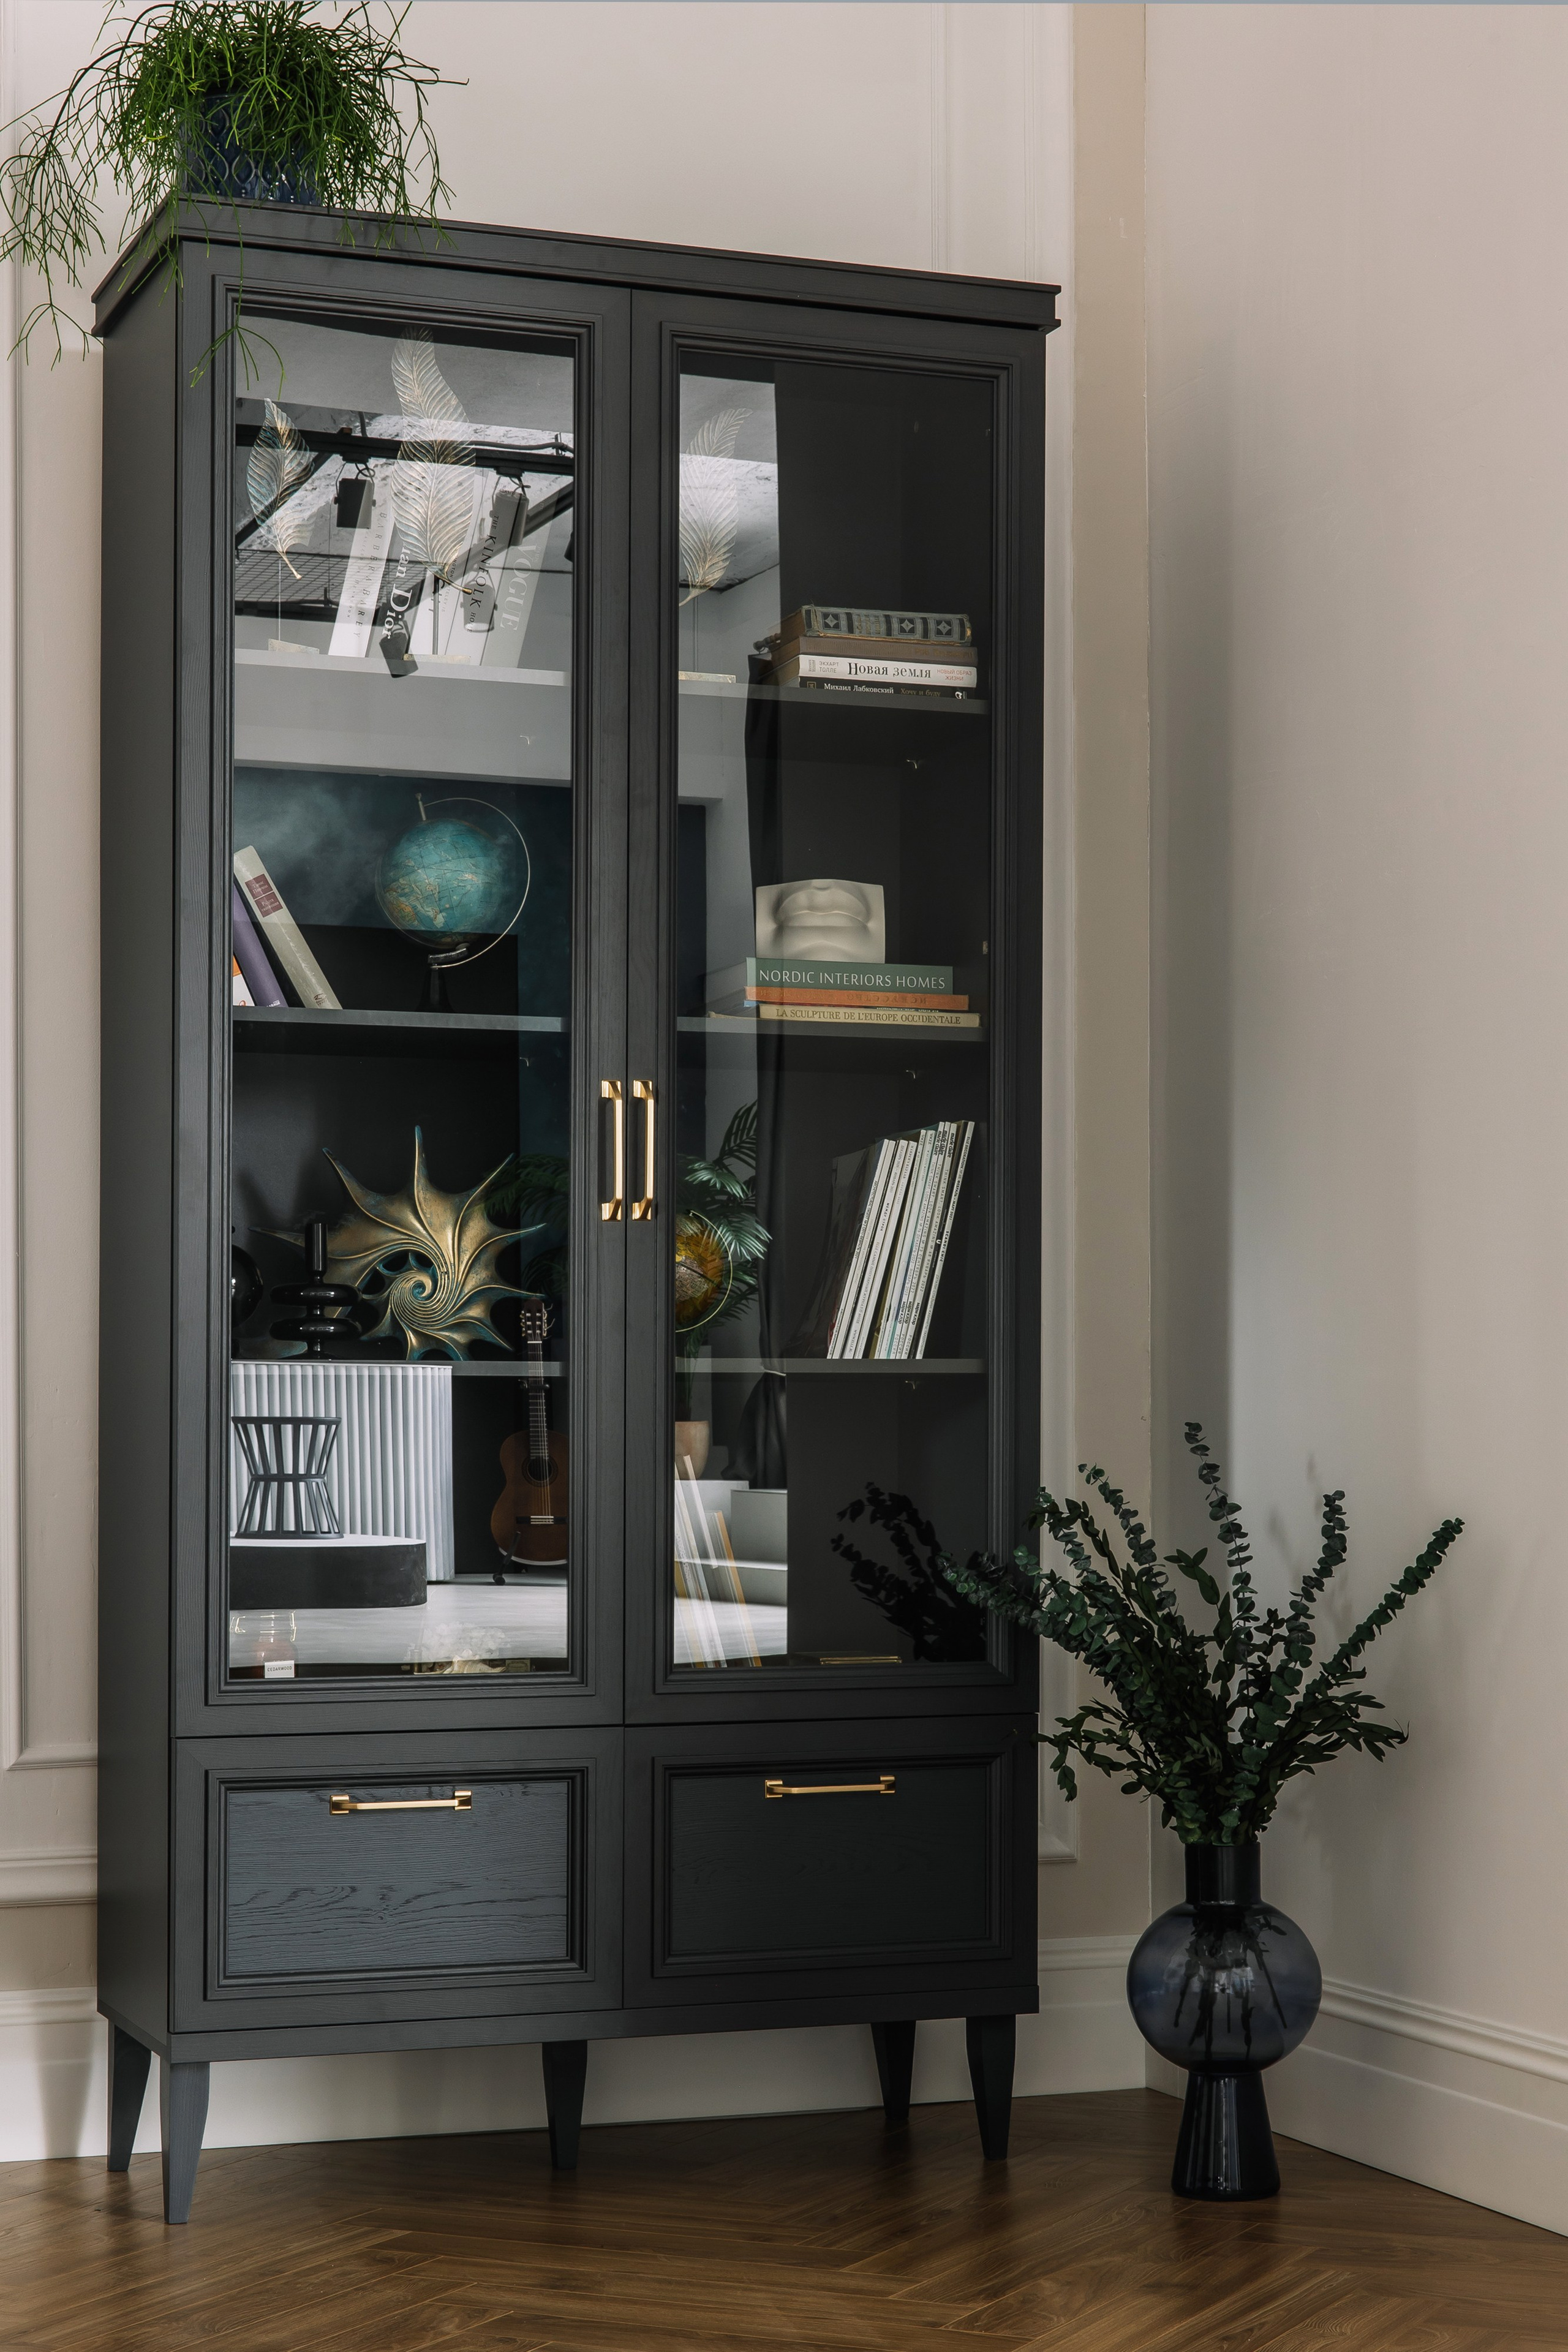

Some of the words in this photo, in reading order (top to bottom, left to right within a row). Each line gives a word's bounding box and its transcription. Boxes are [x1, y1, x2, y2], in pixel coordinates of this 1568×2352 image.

[470, 534, 497, 609] KINFOLK
[496, 540, 541, 632] VOGUE
[382, 583, 413, 641] Dior
[848, 662, 889, 676] Новая
[893, 668, 932, 679] земля
[852, 684, 894, 694] Лабковский
[759, 970, 815, 984] NORDIC
[820, 973, 892, 987] INTERIORS
[896, 976, 946, 989] HOMES
[776, 1009, 788, 1018] LA
[790, 1010, 841, 1020] SCULPTURE
[843, 1012, 857, 1021] DE
[858, 1012, 898, 1023] L'EUROPE
[900, 1013, 961, 1024] OCCIDENTALE
[960, 1145, 969, 1169] DECORATION
[914, 1254, 922, 1280] СЕНТЯБРЬ
